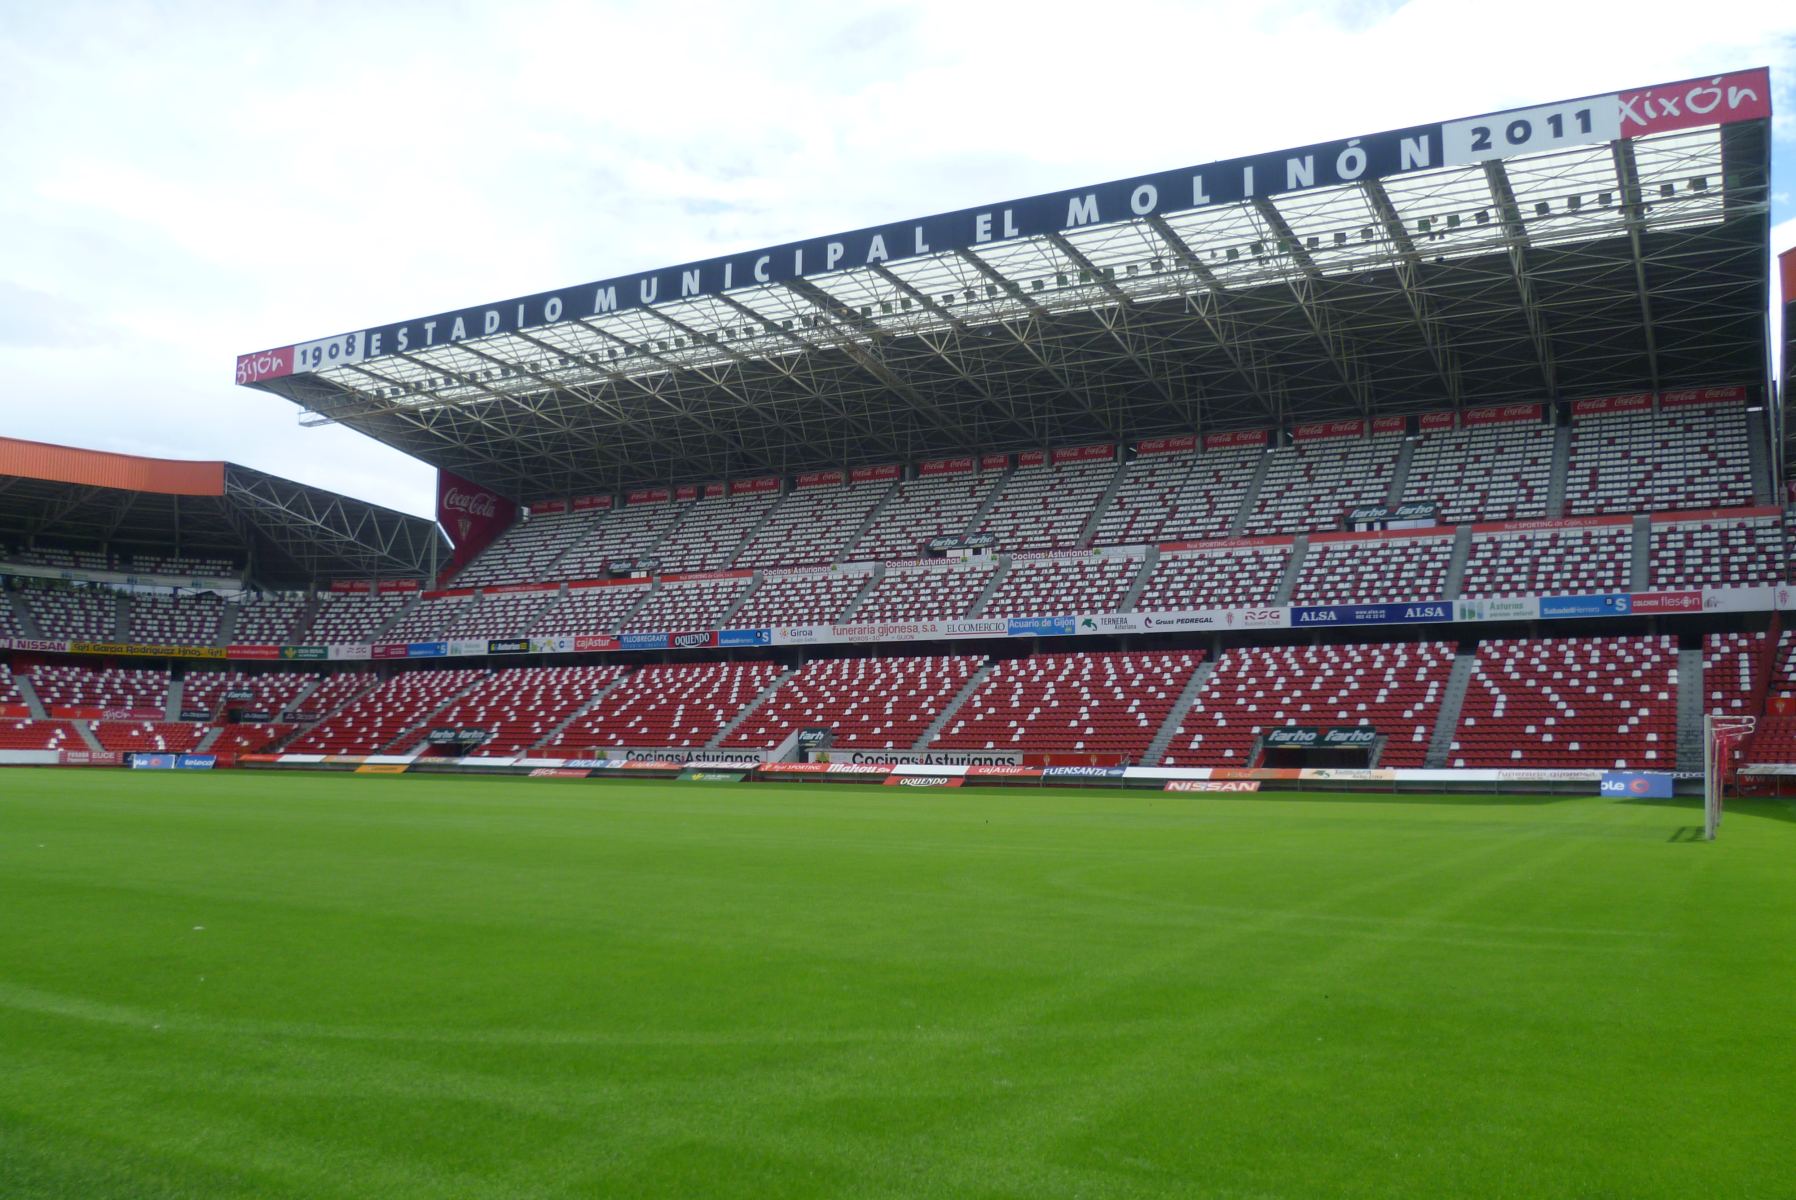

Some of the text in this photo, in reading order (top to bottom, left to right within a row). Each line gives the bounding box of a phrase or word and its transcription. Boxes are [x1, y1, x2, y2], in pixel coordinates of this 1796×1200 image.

[1471, 109, 1591, 153] 2011
[371, 134, 1430, 356] ESTADIO MUNICIPAL EL MOLINÓN
[300, 334, 356, 368] 1908
[1011, 549, 1092, 560] Cocinas Asturianas
[886, 557, 960, 568] Cocinas Asturianas
[763, 566, 831, 576] Cocinas Asturianas
[1300, 611, 1337, 622] ALSA
[1404, 607, 1444, 618] ALSA
[1009, 619, 1040, 629] Acuario
[1042, 618, 1051, 627] de
[1101, 617, 1128, 625] TERNERA
[791, 628, 813, 637] Giroa
[832, 625, 876, 636] funeraria
[947, 622, 1005, 633] EL COMERCIO
[675, 632, 710, 646] OQUENDO
[17, 639, 67, 651] NISSAN
[1268, 730, 1317, 742] farho
[1324, 729, 1375, 742] farho
[626, 749, 681, 763] Cocinas
[686, 749, 760, 763] Asturianas
[852, 752, 1015, 767] Cocinas Asturianas
[1042, 766, 1108, 776] FUENSANTA
[900, 777, 948, 787] OQUENDO
[1167, 781, 1258, 792] NISSAN
